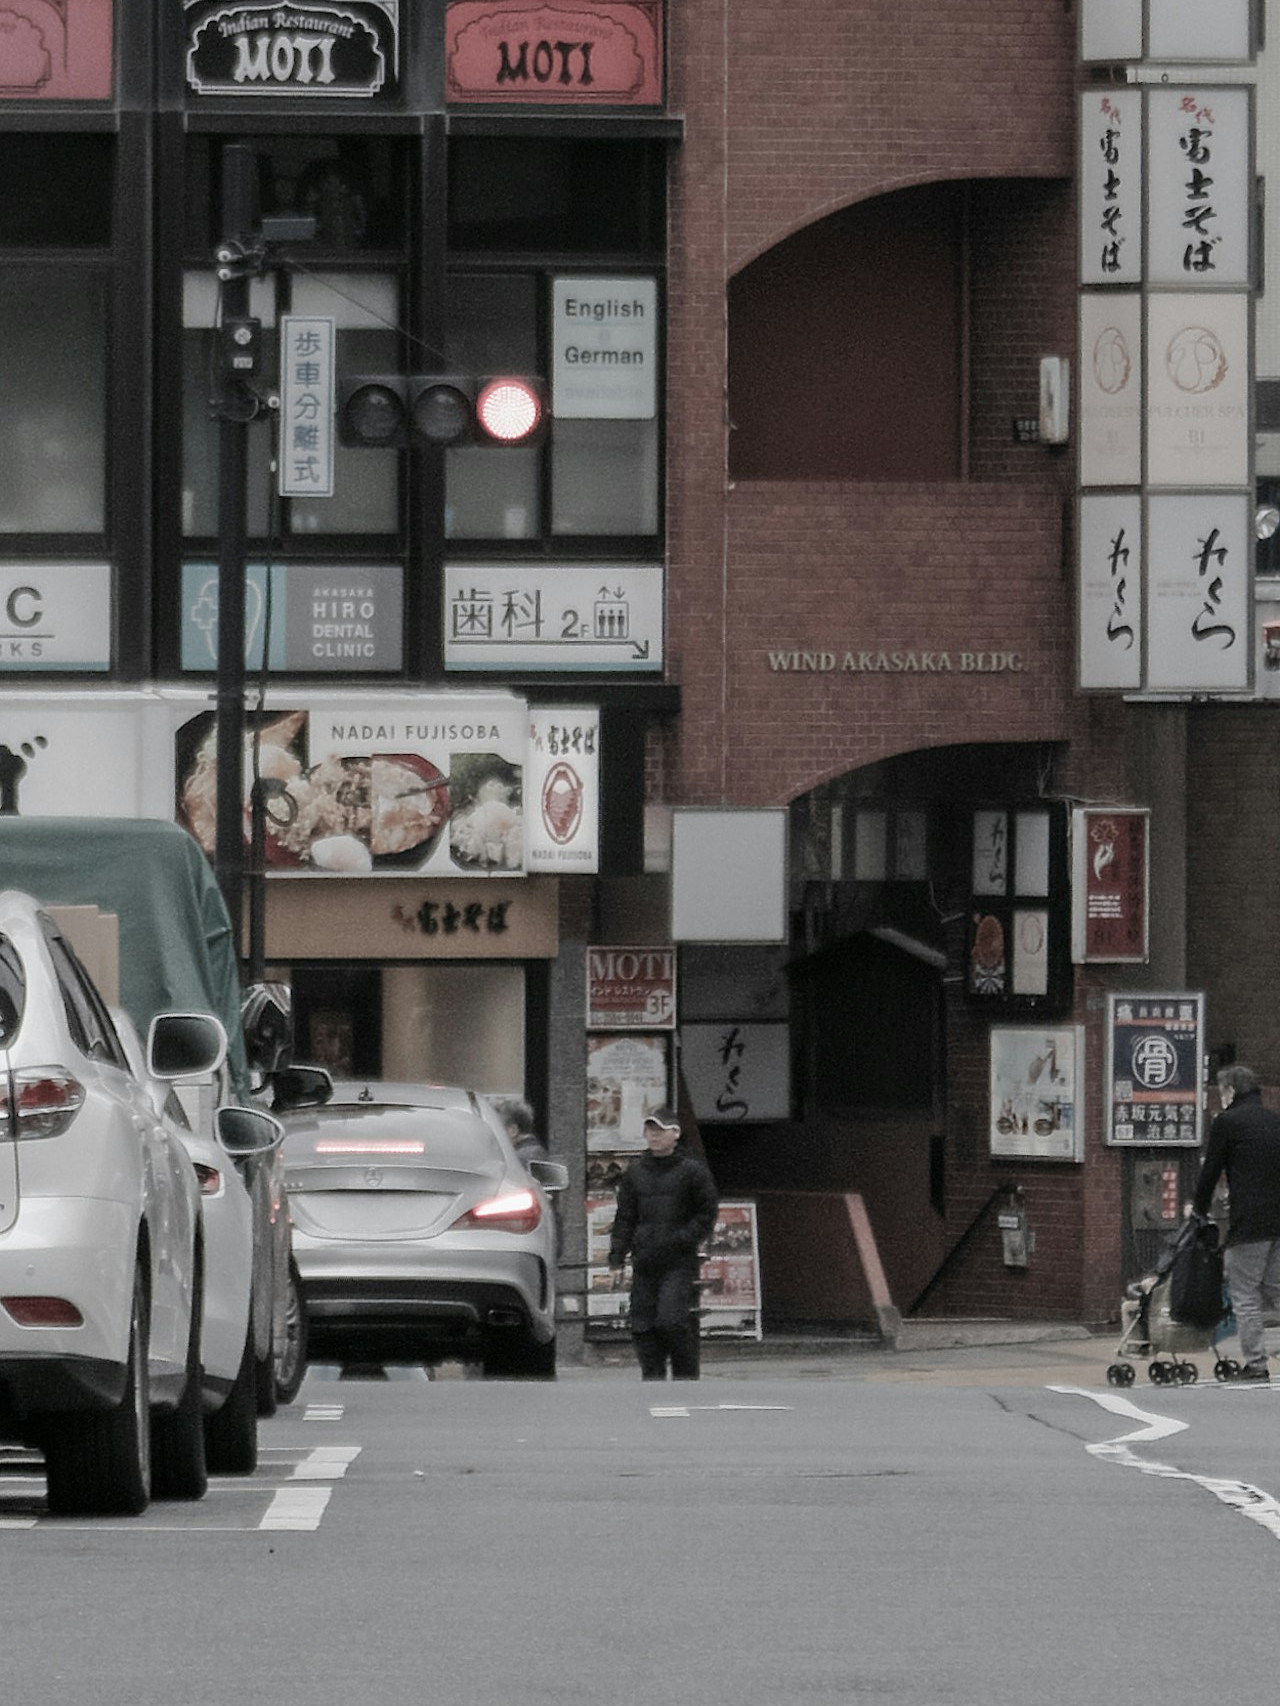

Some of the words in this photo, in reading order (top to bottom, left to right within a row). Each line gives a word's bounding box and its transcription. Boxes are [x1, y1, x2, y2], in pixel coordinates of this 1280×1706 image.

[218, 15, 267, 39] Indian
[274, 12, 354, 39] Restaurant
[233, 36, 336, 84] MOTI
[496, 41, 594, 87] MOTI
[1100, 128, 1122, 273] 富士そば
[1178, 128, 1222, 273] 富士そば
[565, 300, 645, 322] English
[565, 346, 644, 366] German
[294, 331, 321, 484] 歩車分離式
[313, 602, 375, 619] HIRO
[451, 589, 545, 638] 歯科
[561, 609, 590, 639] 2F
[312, 624, 374, 639] DENTAL
[312, 643, 376, 657] CLINIC
[769, 652, 836, 672] WIND
[843, 652, 952, 672] AKASAKA
[331, 725, 395, 740] NADAI
[405, 725, 501, 740] FUJISOBA
[590, 953, 672, 980] MOTI
[648, 994, 670, 1015] 3F
[1138, 1040, 1172, 1083] 骨
